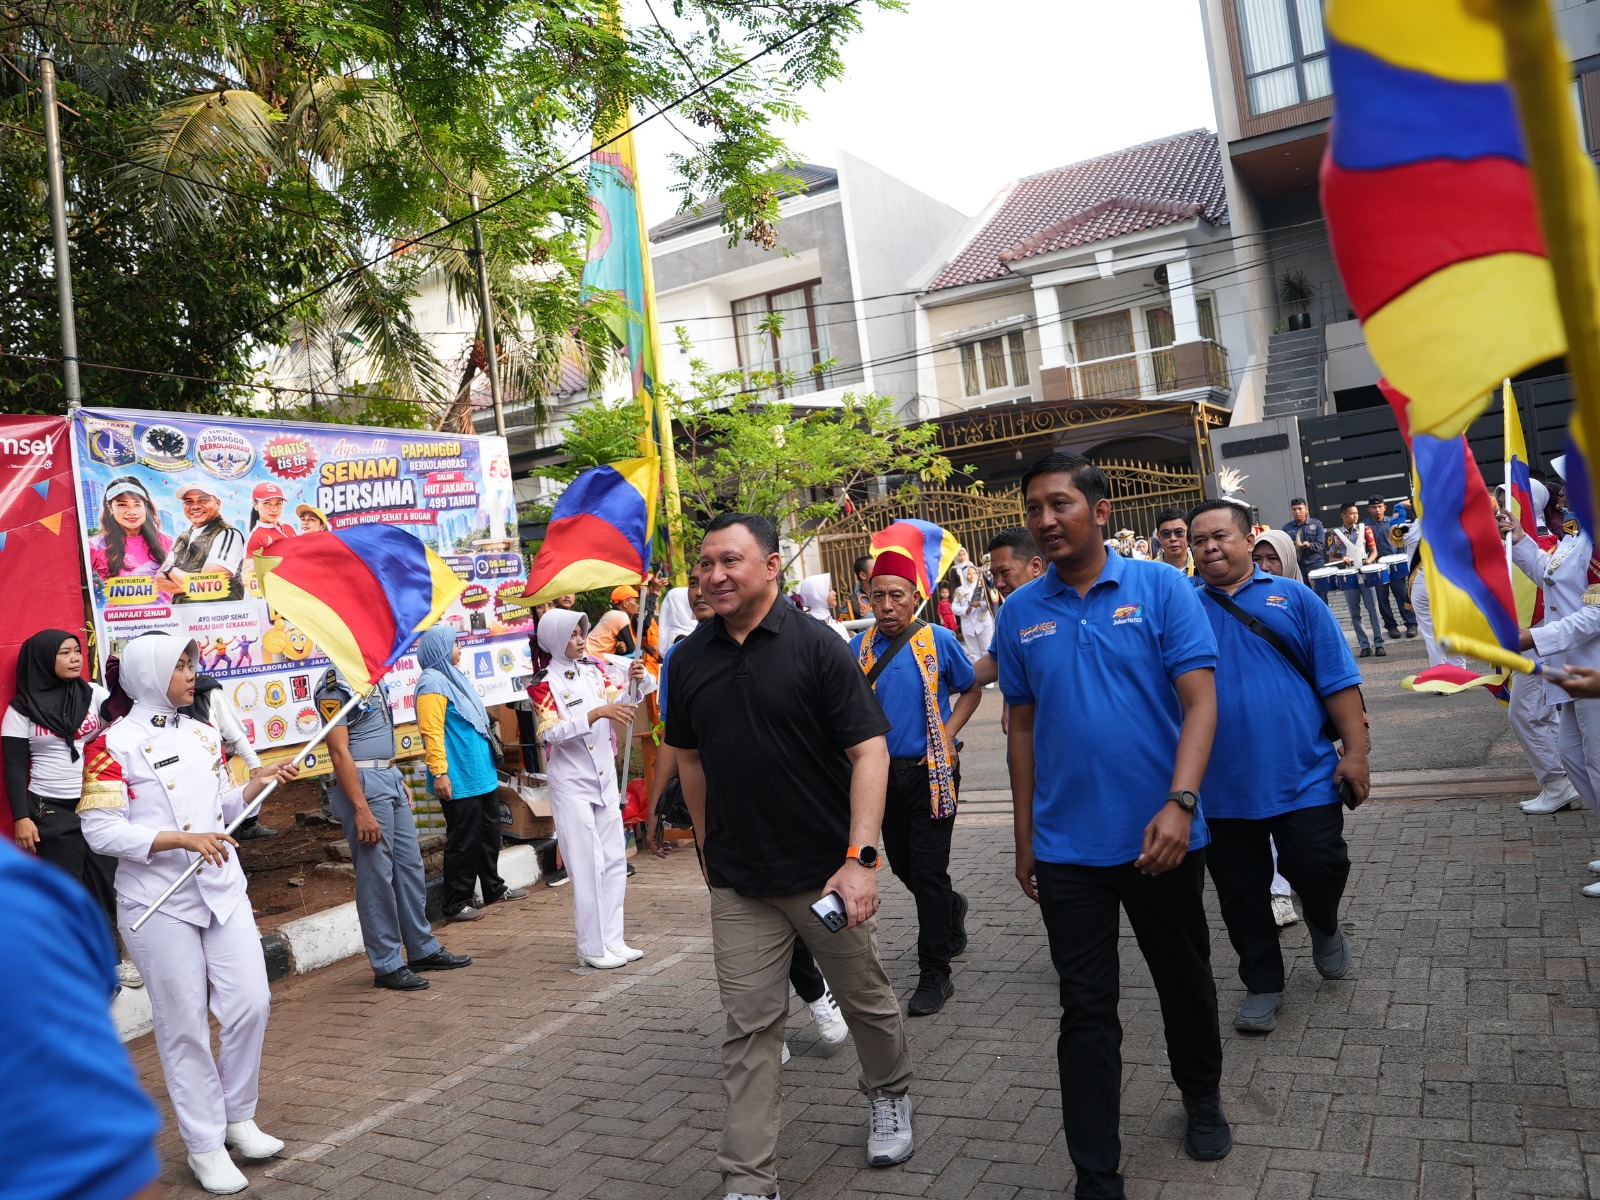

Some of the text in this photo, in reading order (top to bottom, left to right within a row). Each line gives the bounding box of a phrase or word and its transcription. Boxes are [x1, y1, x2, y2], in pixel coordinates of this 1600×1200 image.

[202, 435, 244, 445] PAPANGGO
[200, 442, 250, 453] BERKOLABORASI
[269, 442, 308, 458] GRATIS
[401, 442, 461, 459] PAPANGGO
[277, 454, 308, 470] tis tis
[409, 458, 468, 472] BERKOLABORASI
[320, 457, 398, 485] SENAM
[436, 473, 455, 481] DALAM
[424, 482, 475, 496] HUT JAKARTA
[318, 480, 415, 515] BERSAMA
[428, 495, 477, 509] 499 TAHUN
[336, 516, 359, 528] UNTUK
[359, 514, 381, 524] HIDUP
[381, 512, 402, 522] SEHAT
[409, 512, 431, 521] BUGAR
[109, 584, 153, 598] INDAH
[189, 580, 223, 593] ANTO
[107, 609, 167, 620] MANFAAT SENAM
[211, 614, 230, 622] HIDUP
[502, 607, 530, 621] MENARIK!
[114, 624, 153, 632] Meningkatkan
[188, 624, 211, 632] MULAI
[225, 620, 258, 629] SEKARANG!
[1112, 617, 1134, 626] Jakarta
[230, 662, 295, 676] BERKOLABORASI
